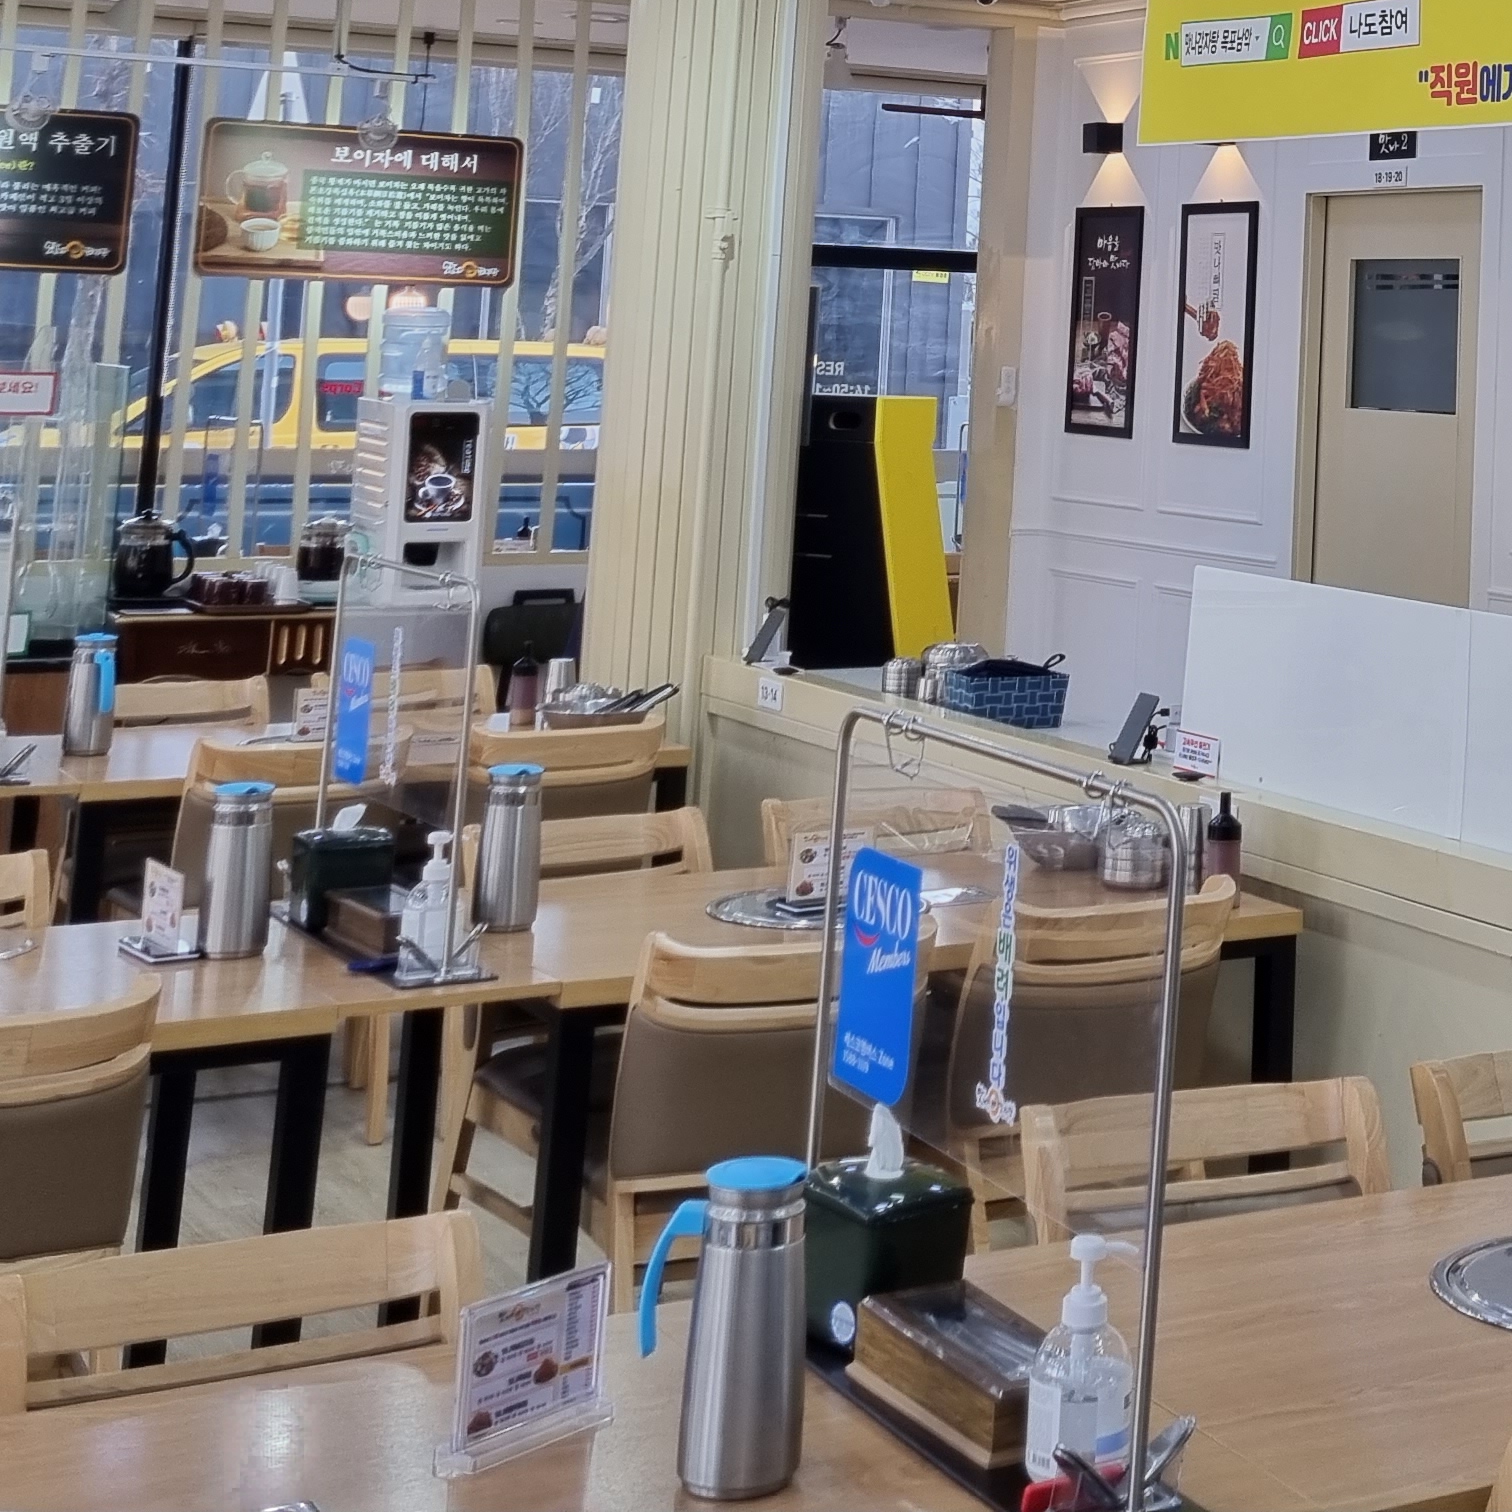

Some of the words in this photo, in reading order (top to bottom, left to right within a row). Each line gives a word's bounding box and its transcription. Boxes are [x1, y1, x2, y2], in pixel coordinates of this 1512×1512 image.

[1302, 17, 1339, 45] CLICK
[1349, 6, 1409, 40] 나도참여
[1165, 32, 1180, 60] N
[1220, 26, 1253, 53] 목포남악
[48, 132, 118, 157] 추출기
[1401, 133, 1409, 150] 2
[420, 151, 479, 175] 대해서
[853, 868, 912, 941] CESCO
[866, 940, 911, 975] Members
